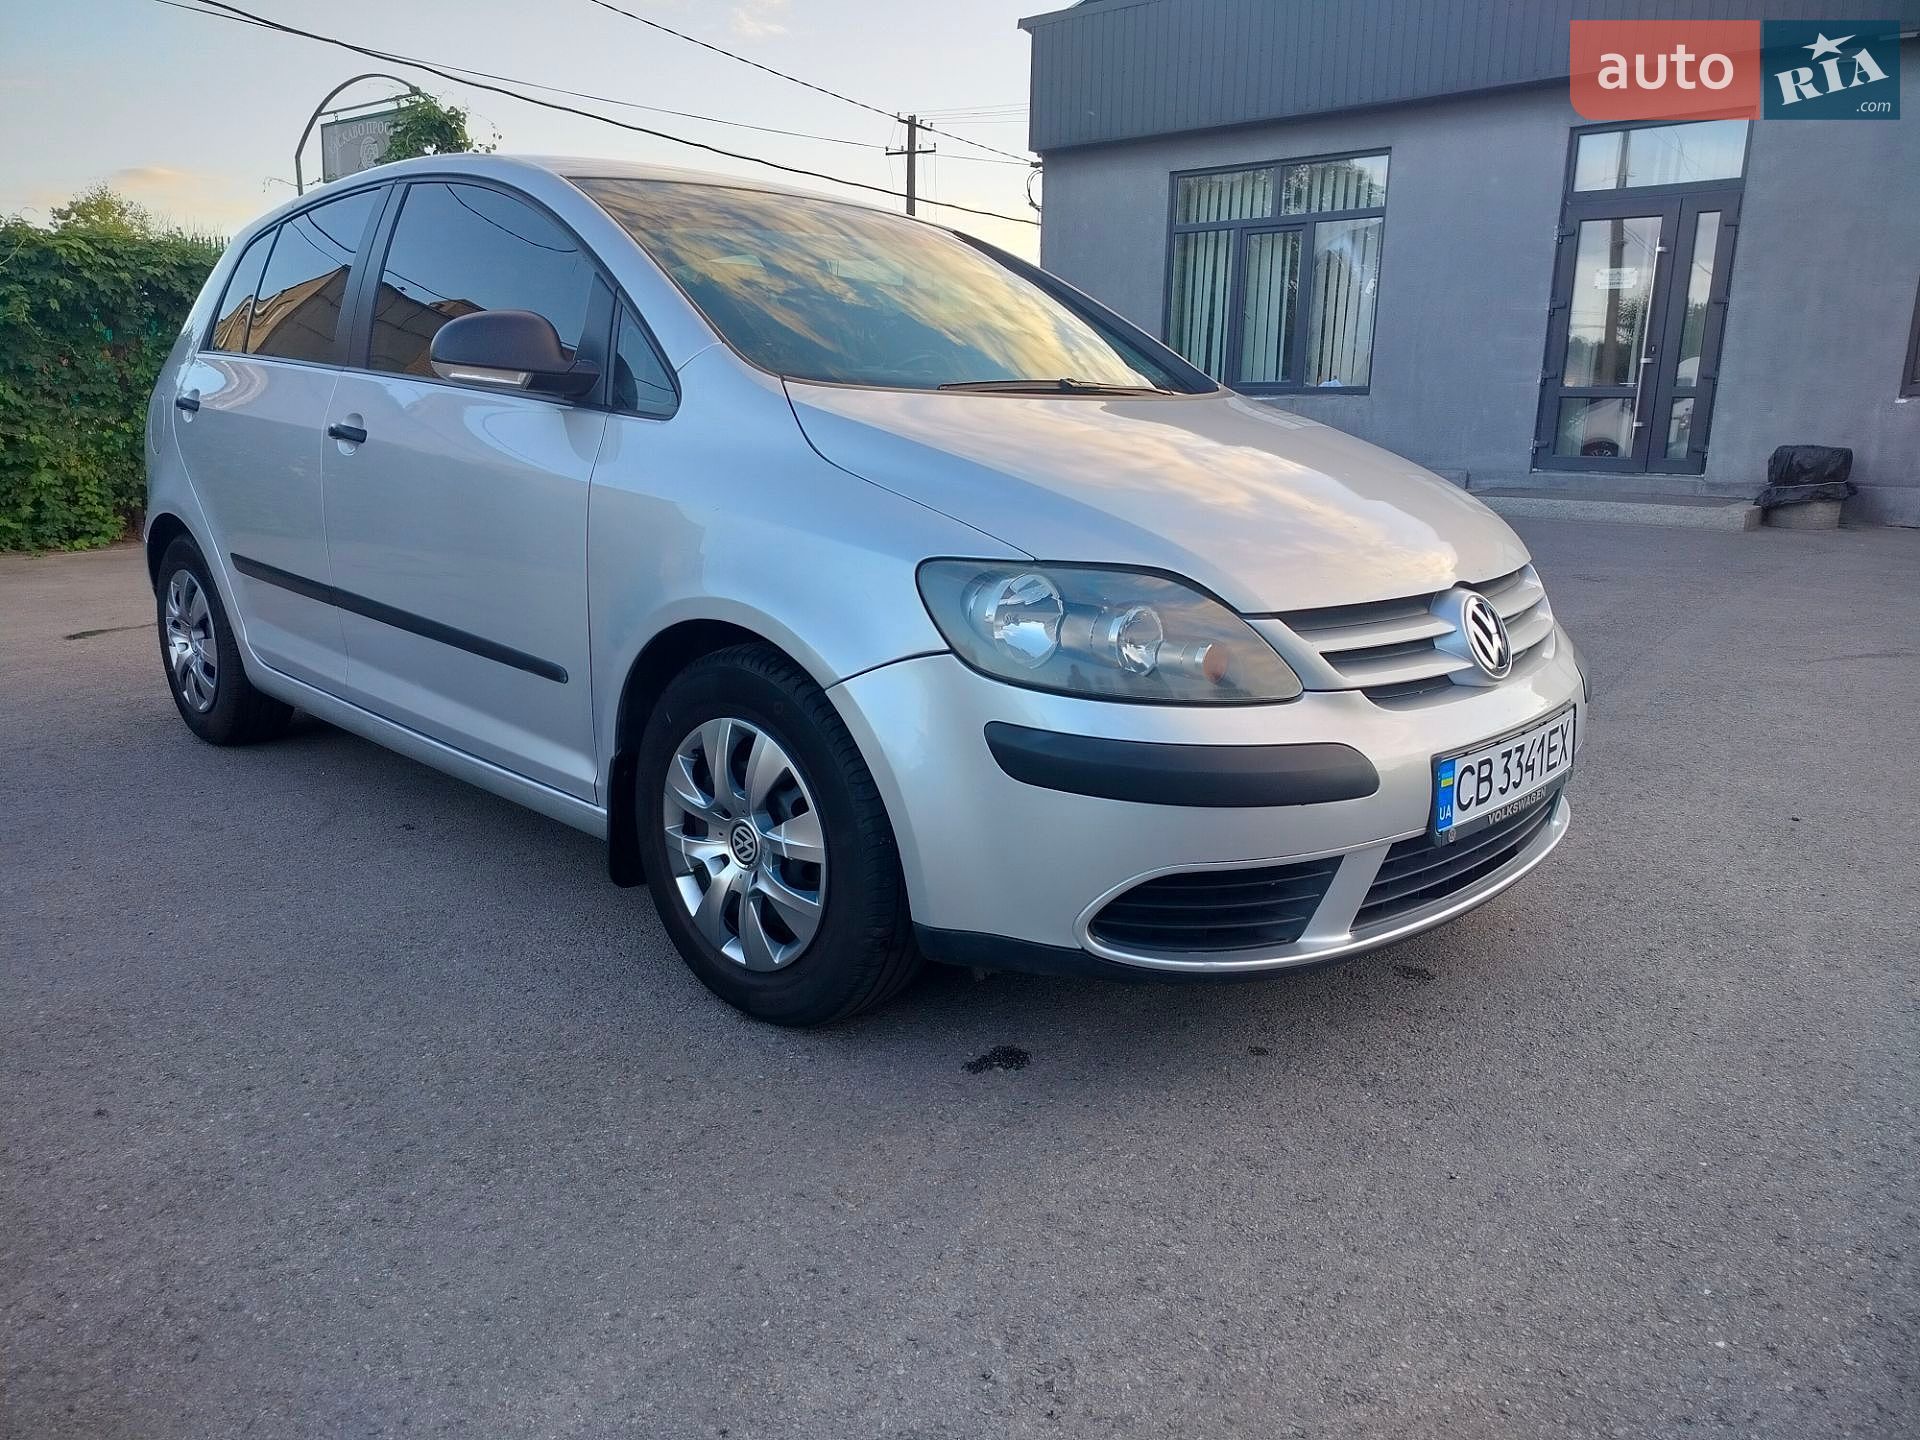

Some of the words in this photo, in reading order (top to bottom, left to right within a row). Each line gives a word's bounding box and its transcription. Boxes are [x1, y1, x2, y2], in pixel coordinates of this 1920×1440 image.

[1456, 757, 1493, 811] CB
[1439, 805, 1452, 820] UA
[1487, 786, 1546, 825] VOLKSWAGEN
